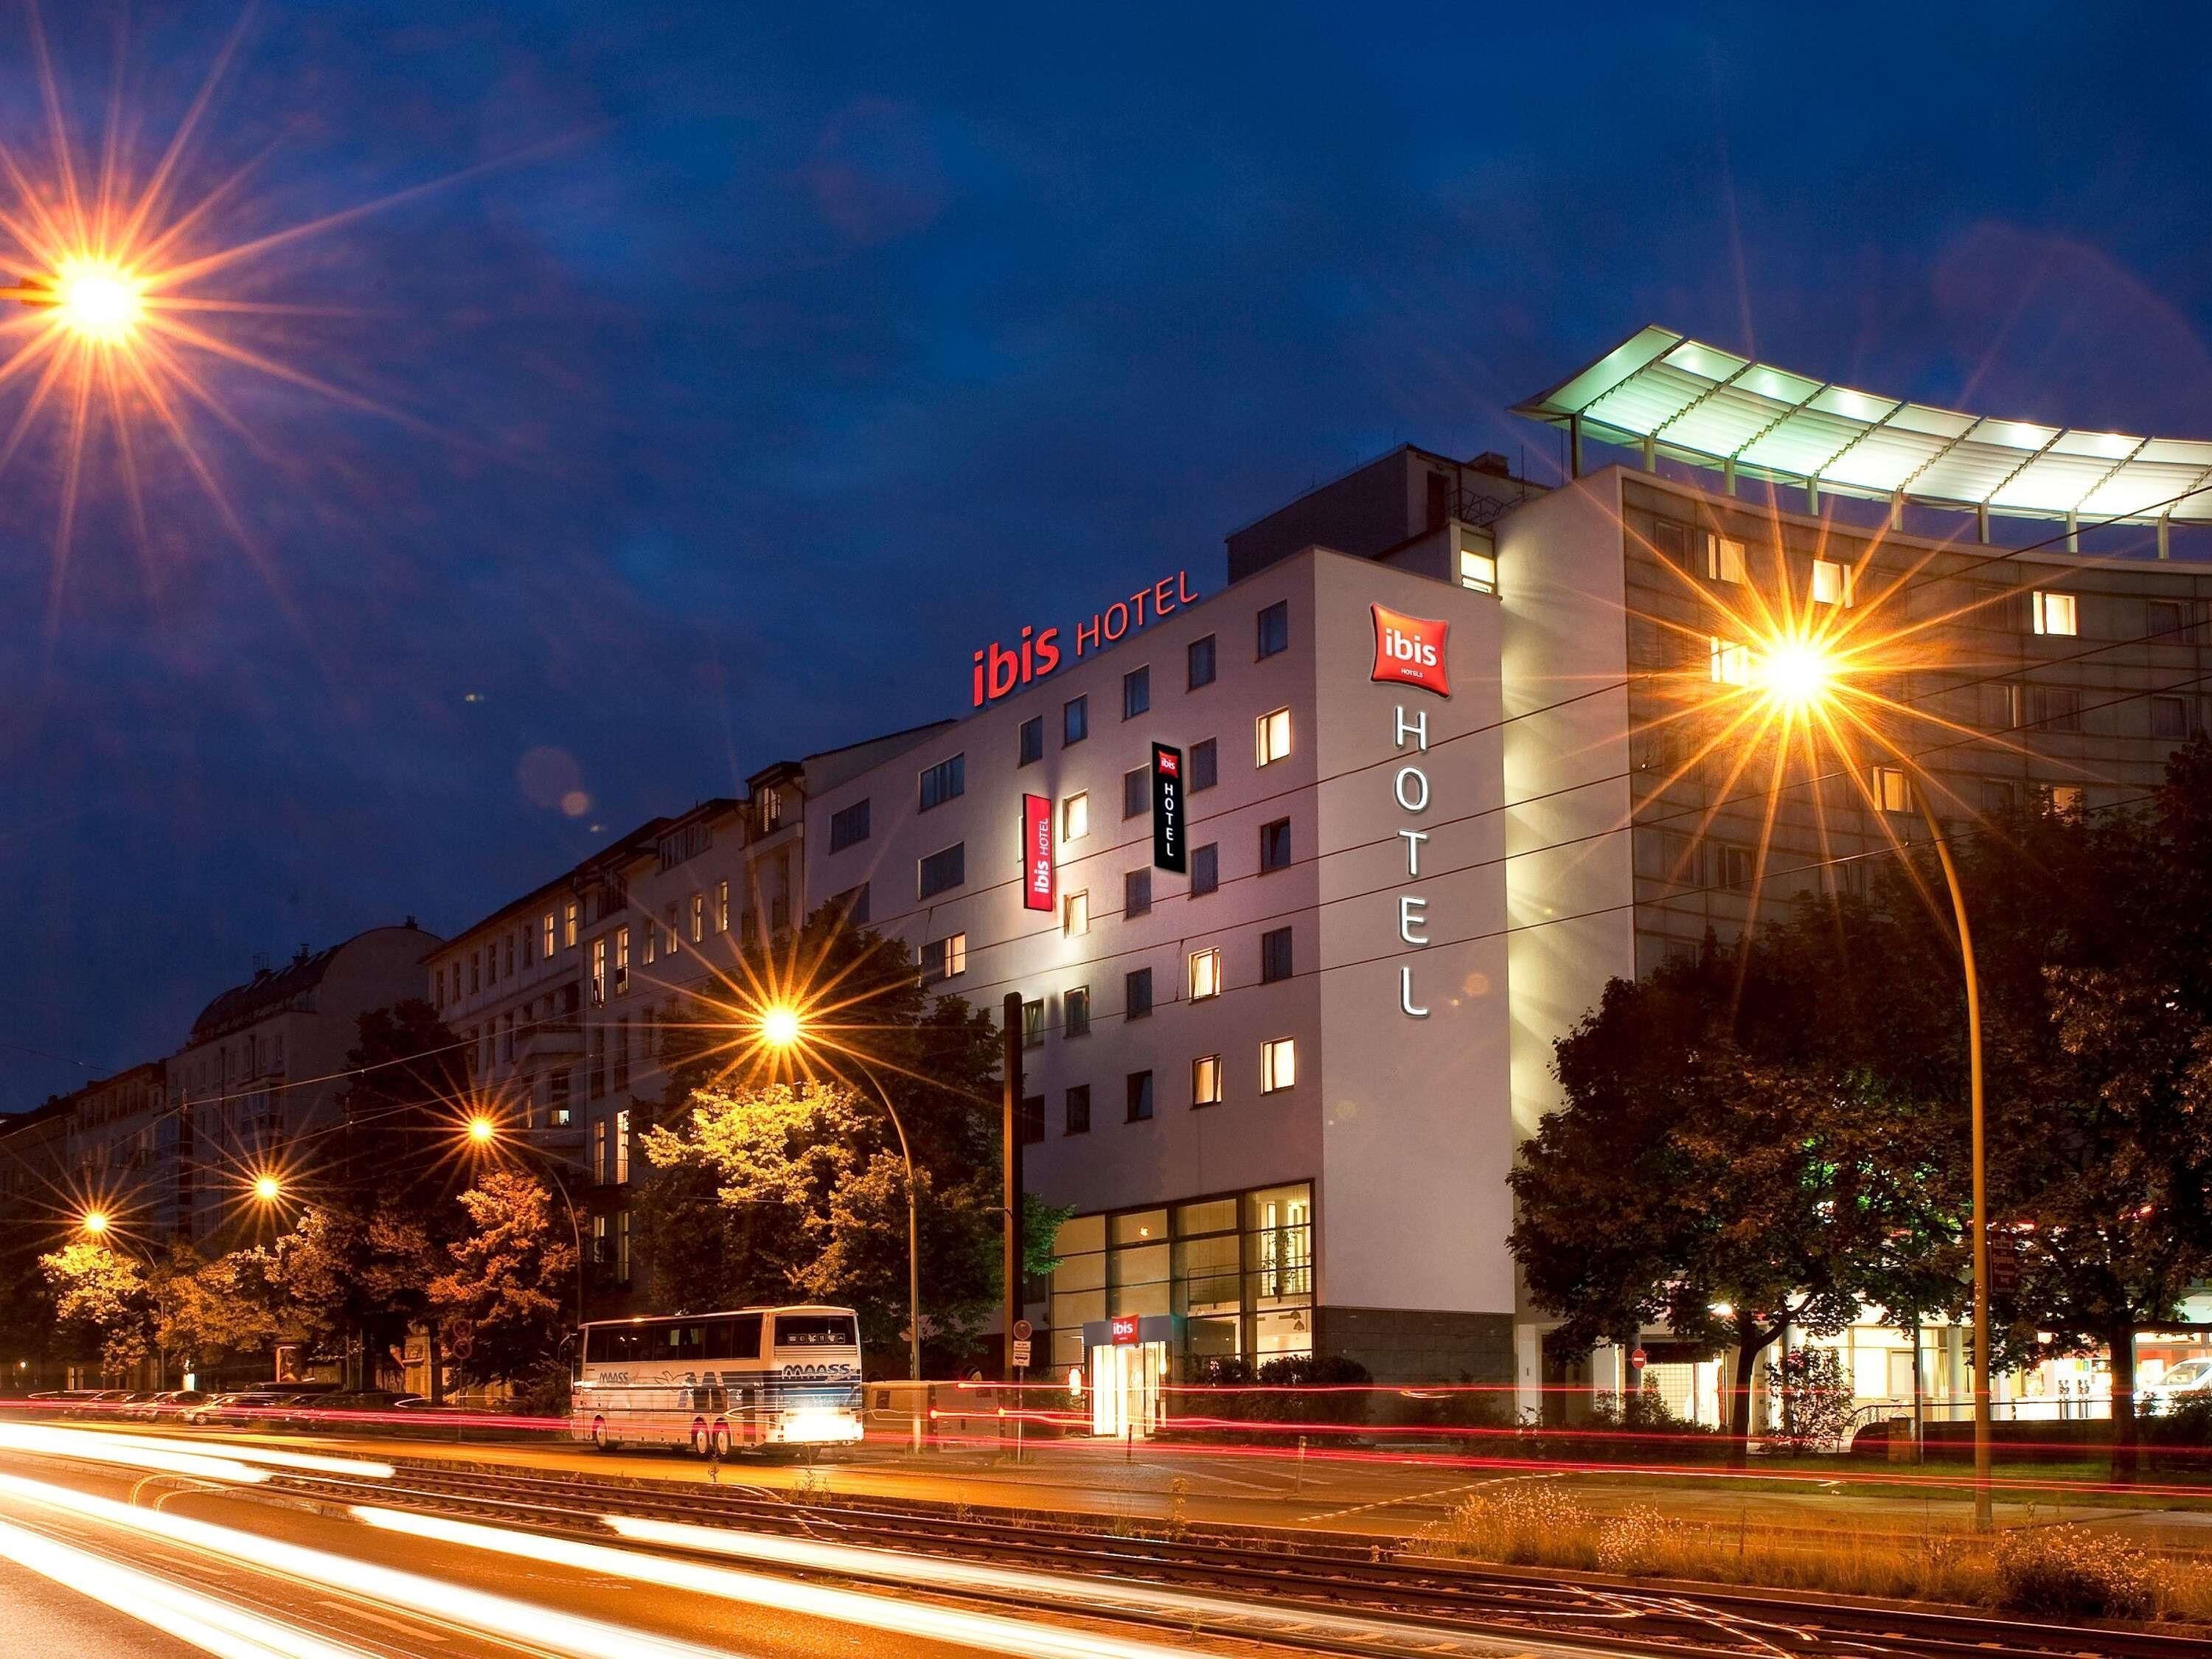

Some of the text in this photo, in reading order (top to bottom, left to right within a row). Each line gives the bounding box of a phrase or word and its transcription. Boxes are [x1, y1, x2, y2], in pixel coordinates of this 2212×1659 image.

[973, 570, 1198, 707] ibis HOTEL
[1385, 627, 1437, 667] ibis
[1401, 667, 1423, 678] HOTELS
[1161, 757, 1175, 771] ibis
[1164, 782, 1174, 857] HOTEL
[1034, 817, 1049, 894] ibis HOTEL
[1394, 706, 1429, 1017] HOTEL
[1113, 1321, 1133, 1335] ibis
